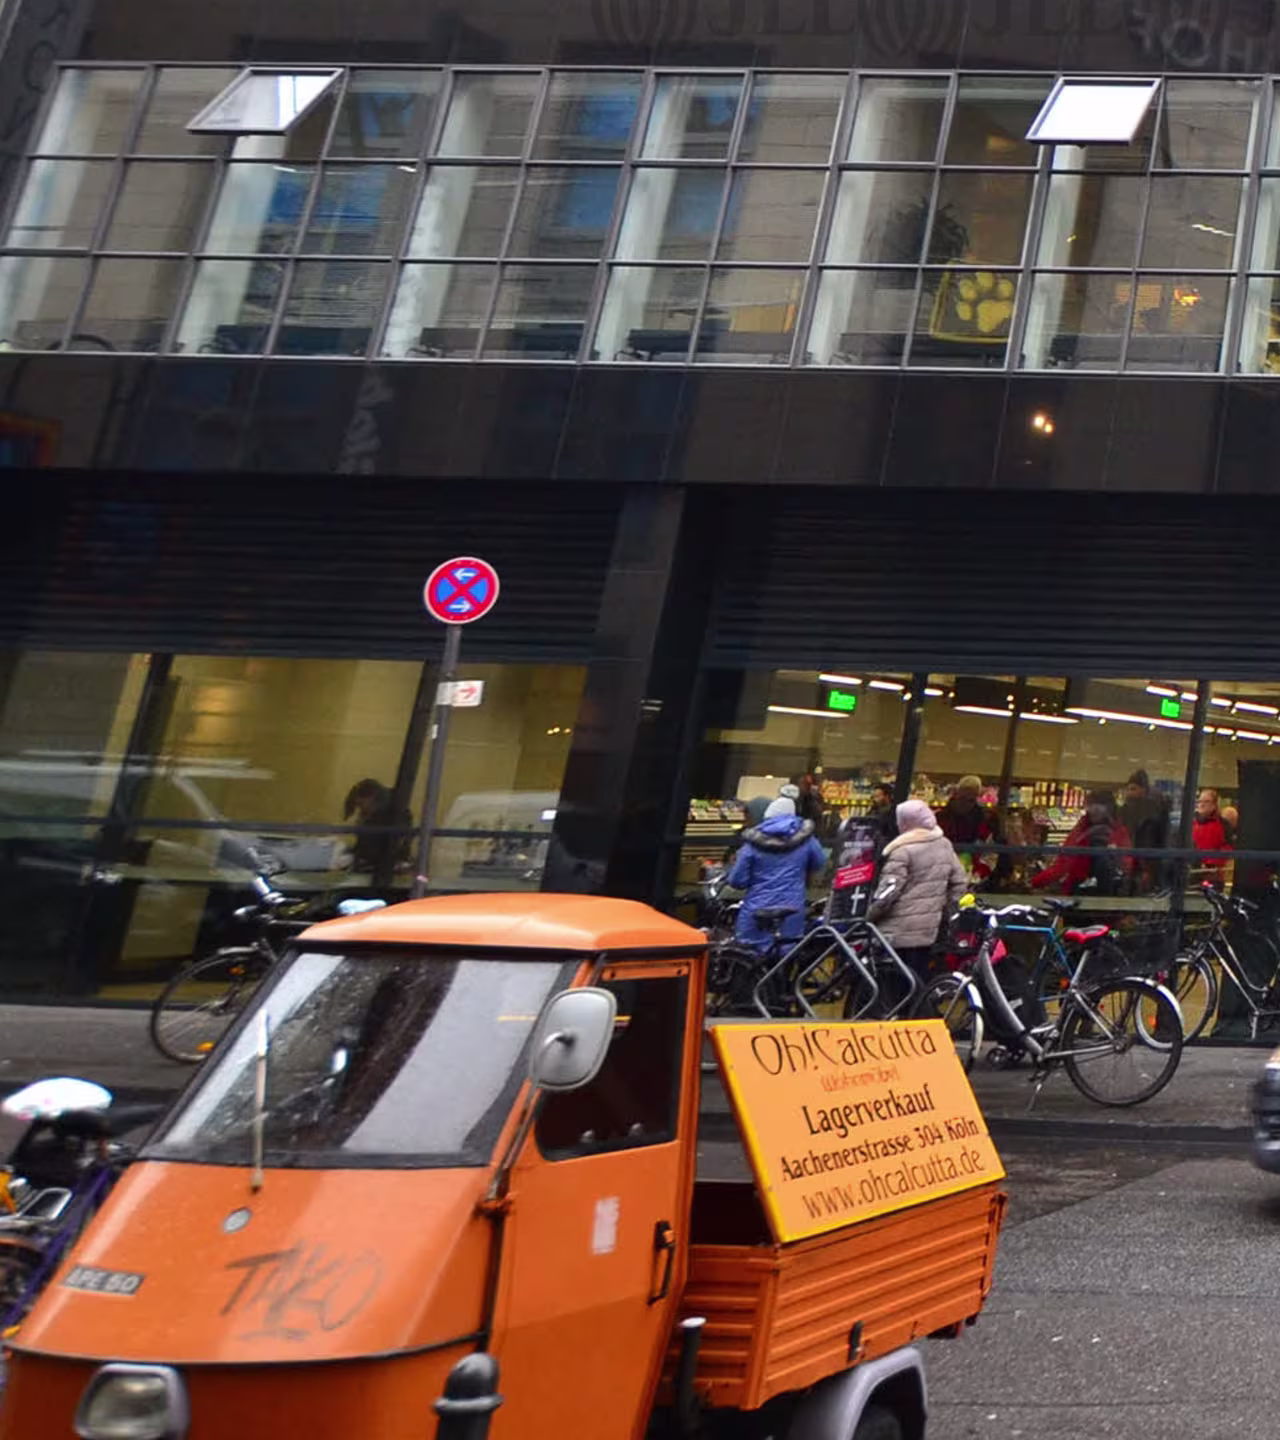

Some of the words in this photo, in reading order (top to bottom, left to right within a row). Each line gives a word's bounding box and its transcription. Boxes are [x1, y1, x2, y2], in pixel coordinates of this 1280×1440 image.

[802, 1083, 935, 1138] Lagerverkauf
[781, 1133, 913, 1182] Aachenerstrasse
[914, 1124, 944, 1148] 304
[945, 1117, 979, 1140] Köln
[802, 1147, 985, 1219] www.ohcalcutta.de
